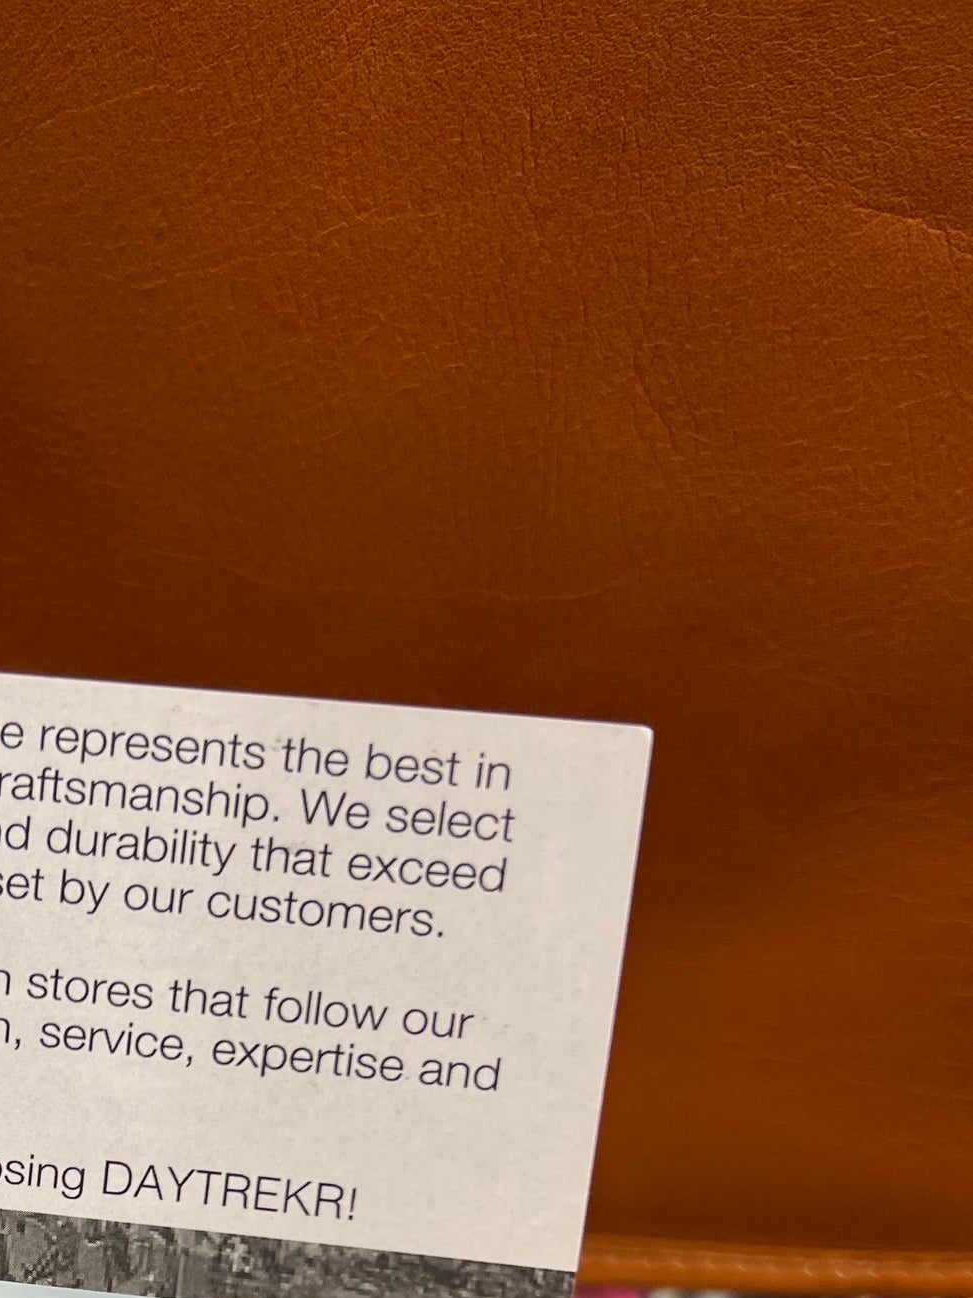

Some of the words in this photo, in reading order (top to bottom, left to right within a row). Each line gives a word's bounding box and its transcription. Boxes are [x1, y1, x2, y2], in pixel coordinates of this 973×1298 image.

[39, 724, 266, 771] represents
[281, 736, 350, 778] the
[364, 742, 462, 787] best
[475, 751, 512, 791] in
[300, 787, 371, 831] We
[385, 800, 516, 843] select
[46, 818, 238, 877] durability
[250, 835, 334, 878] that
[347, 853, 508, 893] exceed
[59, 867, 111, 916] by
[123, 883, 195, 915] our
[206, 890, 444, 939] customers.
[26, 968, 154, 1010] stores
[168, 978, 250, 1019] that
[263, 986, 389, 1032] follow
[401, 1008, 475, 1040] our
[39, 1021, 193, 1068] service,
[211, 1039, 405, 1082] expertise
[418, 1057, 502, 1092] and
[102, 1159, 358, 1221] DAYTREKR!
